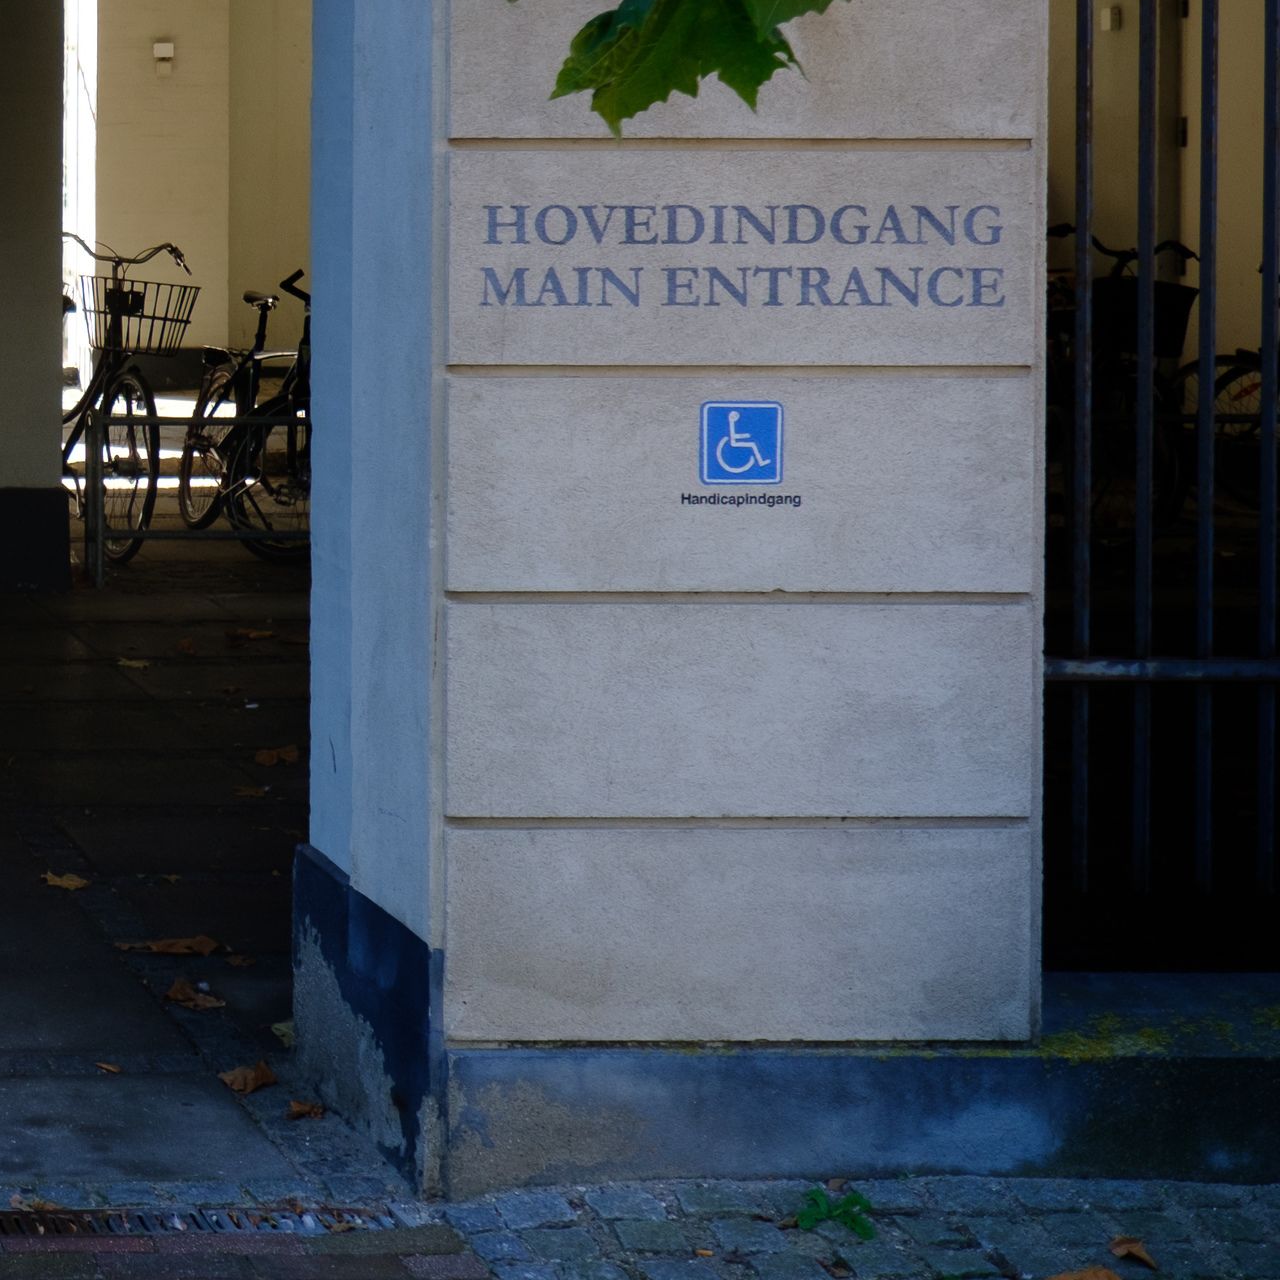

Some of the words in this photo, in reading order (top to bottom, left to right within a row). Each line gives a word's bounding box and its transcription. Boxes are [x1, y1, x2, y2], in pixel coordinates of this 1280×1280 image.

[482, 205, 1003, 246] HOVEDINDGANG
[479, 267, 643, 307] MAIN
[660, 267, 1007, 308] ENTRANCE
[681, 493, 802, 508] Handicapindgang
